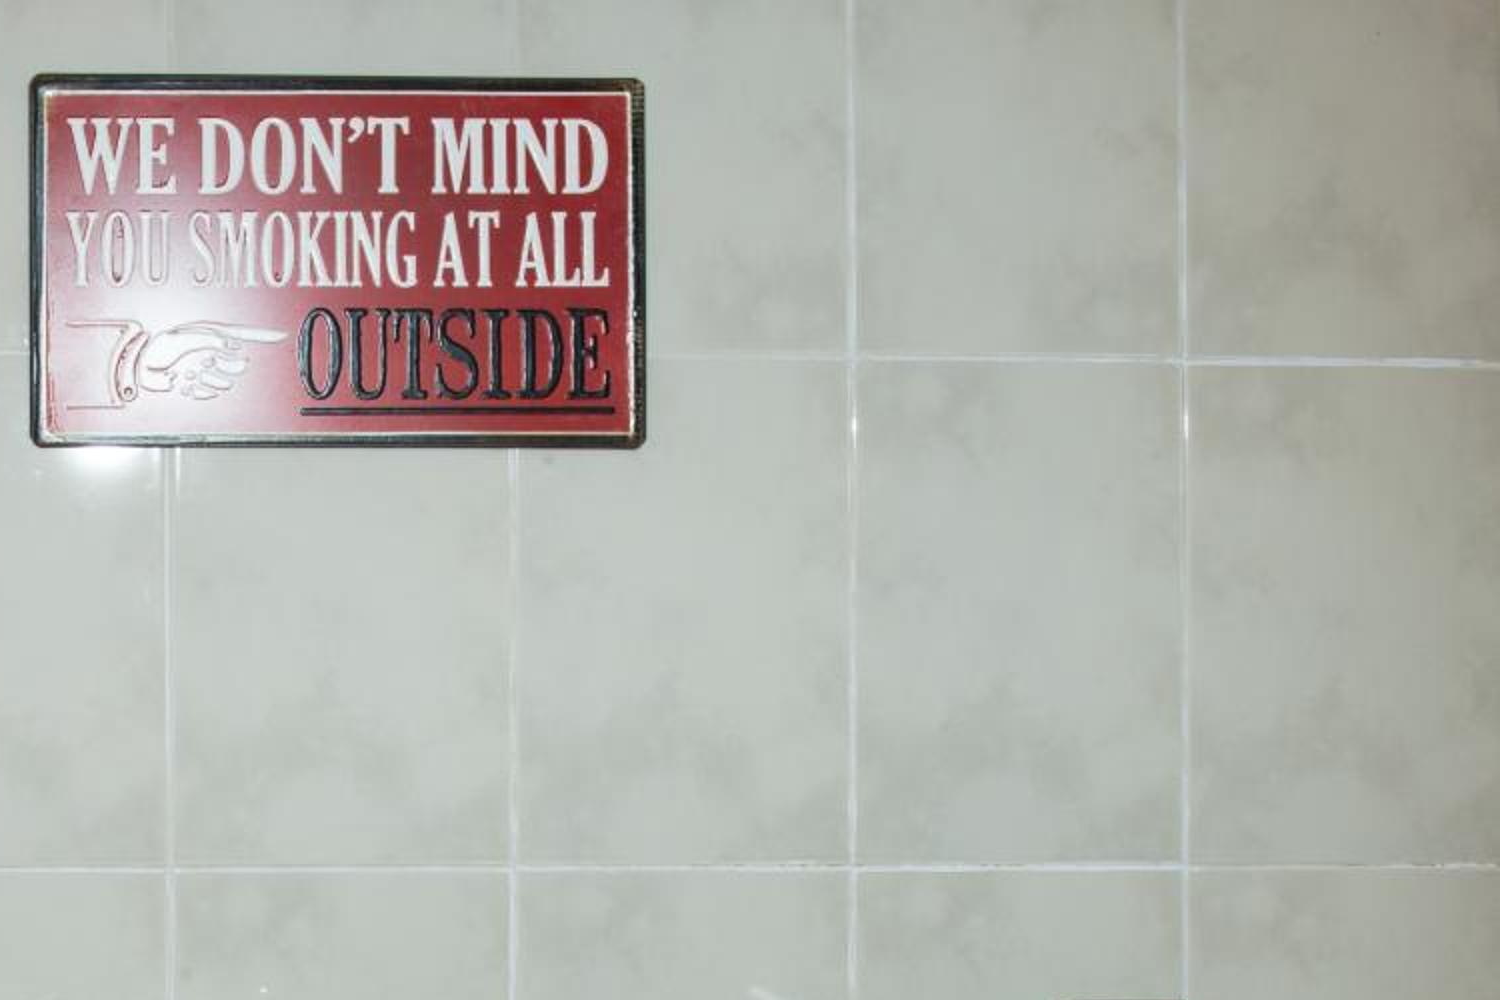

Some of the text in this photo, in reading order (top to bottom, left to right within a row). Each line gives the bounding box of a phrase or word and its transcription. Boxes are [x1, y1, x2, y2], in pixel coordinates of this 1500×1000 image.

[66, 115, 610, 196] WE DON'T MIND
[65, 210, 610, 289] YOU SMOKING AT ALL
[298, 306, 610, 402] OUTSIDE
